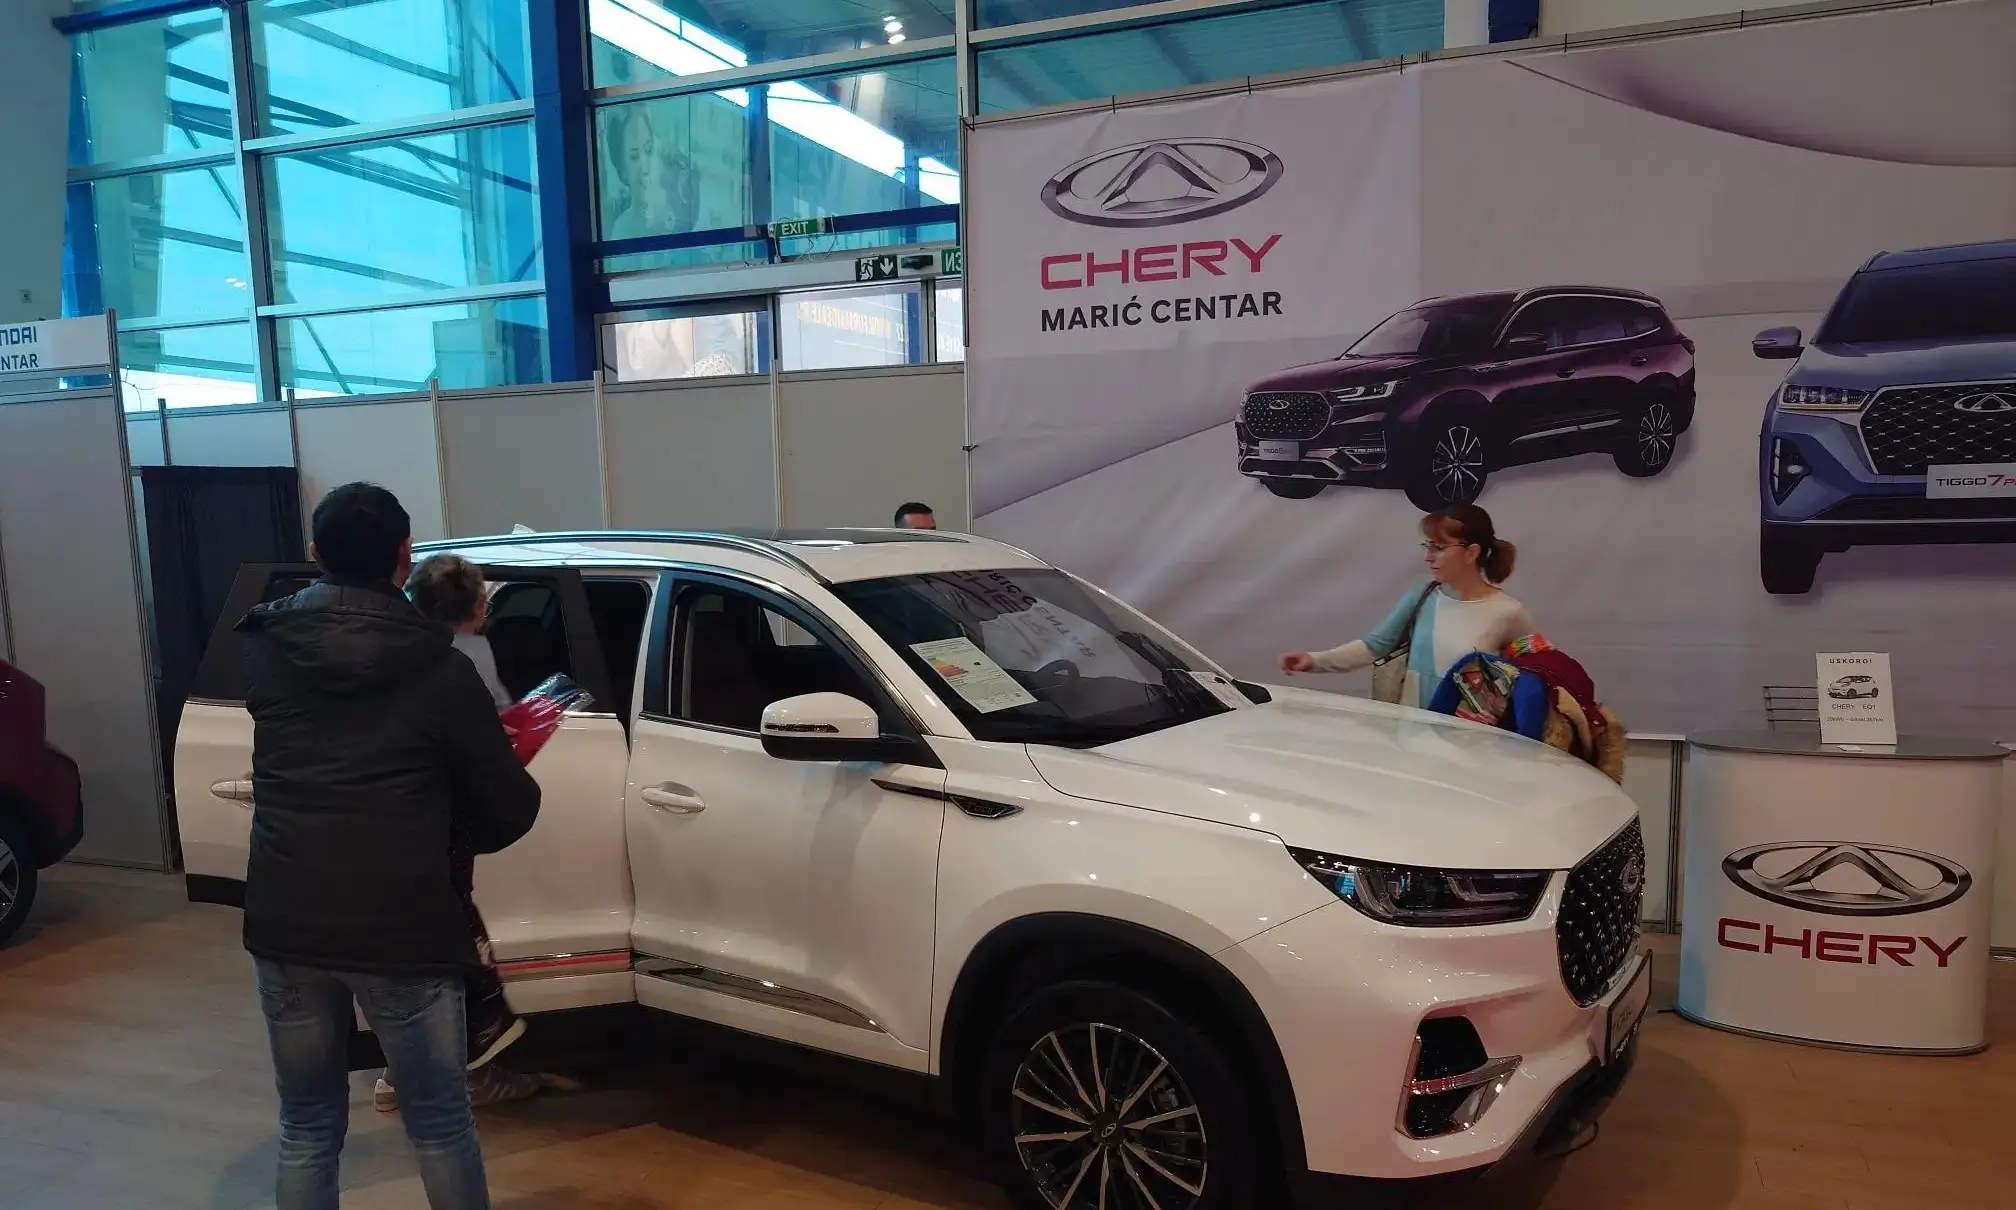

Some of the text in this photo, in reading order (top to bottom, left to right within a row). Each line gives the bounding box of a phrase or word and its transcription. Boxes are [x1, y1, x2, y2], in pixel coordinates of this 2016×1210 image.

[781, 221, 808, 235] EXIT
[1041, 234, 1283, 290] CHERY
[1041, 291, 1283, 332] MARIĆ CENTAR
[1717, 918, 1969, 967] CHERY
